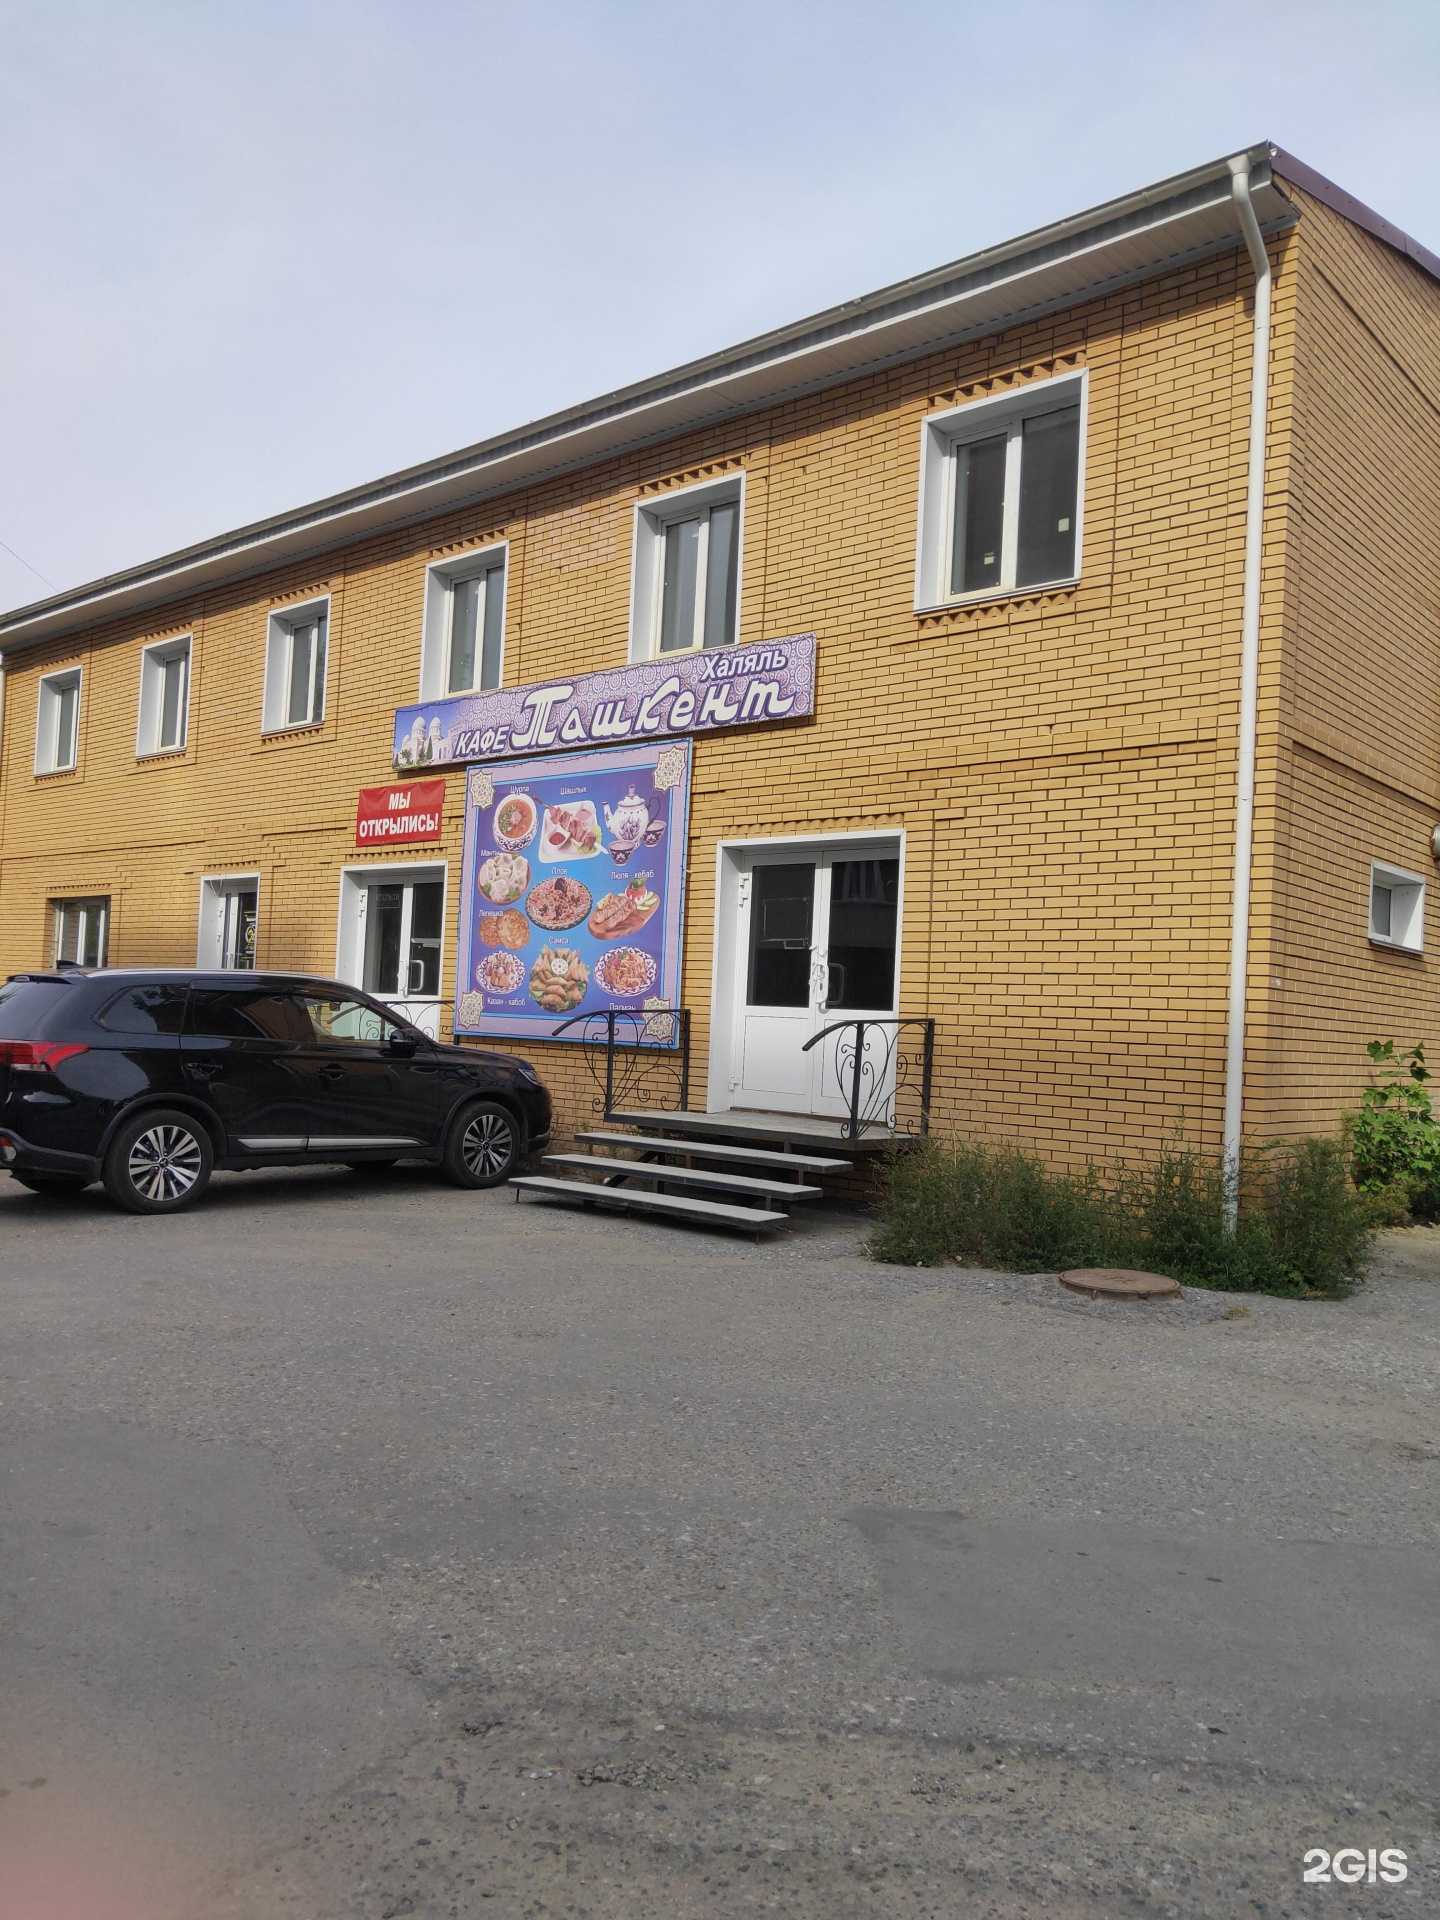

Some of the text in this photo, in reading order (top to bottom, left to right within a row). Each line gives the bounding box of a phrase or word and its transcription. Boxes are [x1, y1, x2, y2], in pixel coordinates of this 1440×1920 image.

[701, 650, 786, 681] Халяль
[455, 676, 795, 756] КАФЕ Ташкент
[388, 792, 411, 811] МЫ
[360, 813, 439, 838] ОТКРЫЛИСЬ!
